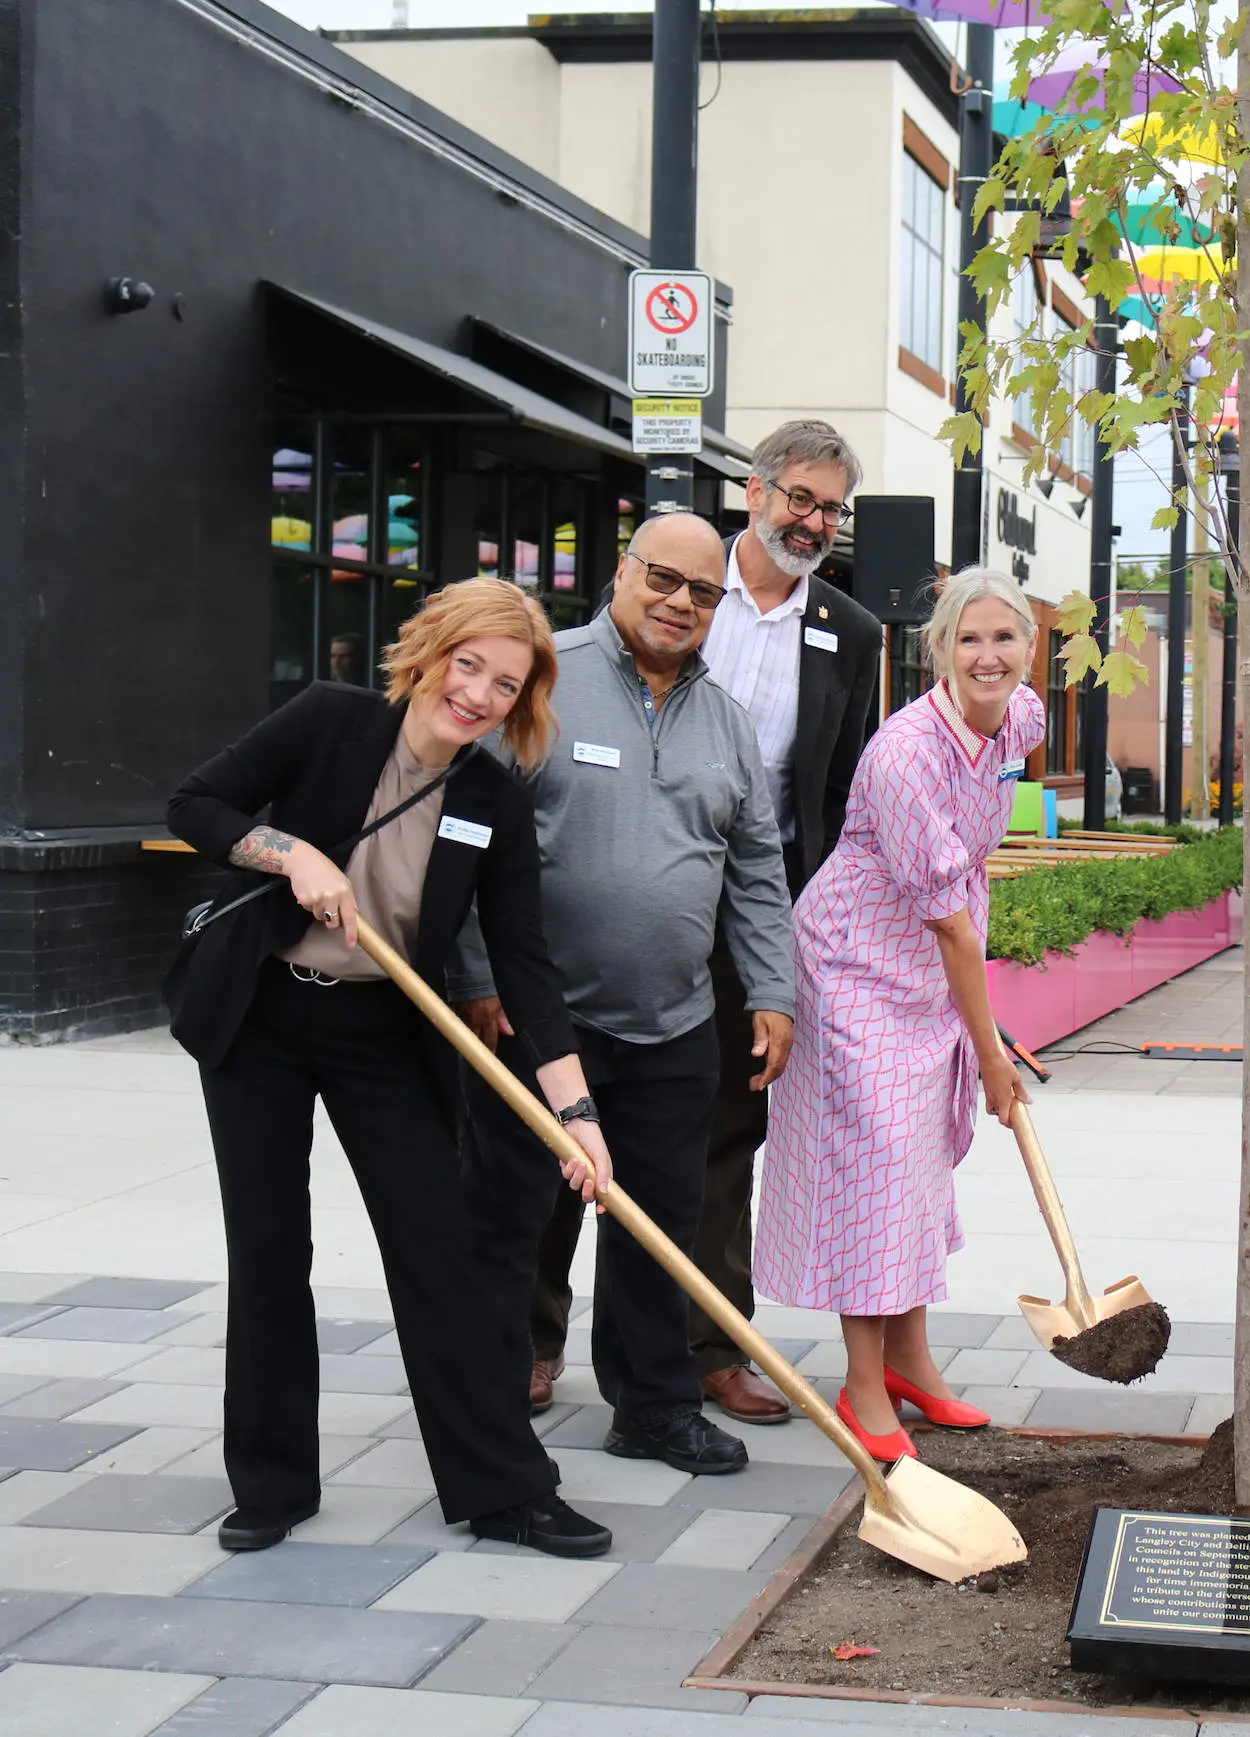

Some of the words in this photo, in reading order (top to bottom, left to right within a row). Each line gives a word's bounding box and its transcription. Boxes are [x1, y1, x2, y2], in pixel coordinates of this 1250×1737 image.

[665, 338, 677, 351] NO
[637, 352, 706, 368] SKATEBOARDING
[636, 404, 671, 412] SECURITY
[673, 404, 699, 412] NOTICE
[1214, 1532, 1250, 1541] planted
[1135, 1536, 1176, 1546] Langley
[1179, 1539, 1201, 1548] City
[1136, 1546, 1181, 1556] Councils
[1141, 1557, 1199, 1567] recognition
[1158, 1567, 1180, 1575] land
[1183, 1568, 1196, 1577] by
[1164, 1577, 1187, 1586] time
[1146, 1587, 1181, 1595] tribute
[1132, 1596, 1165, 1605] whose
[1168, 1599, 1236, 1609] contributions
[1153, 1608, 1179, 1616] unite
